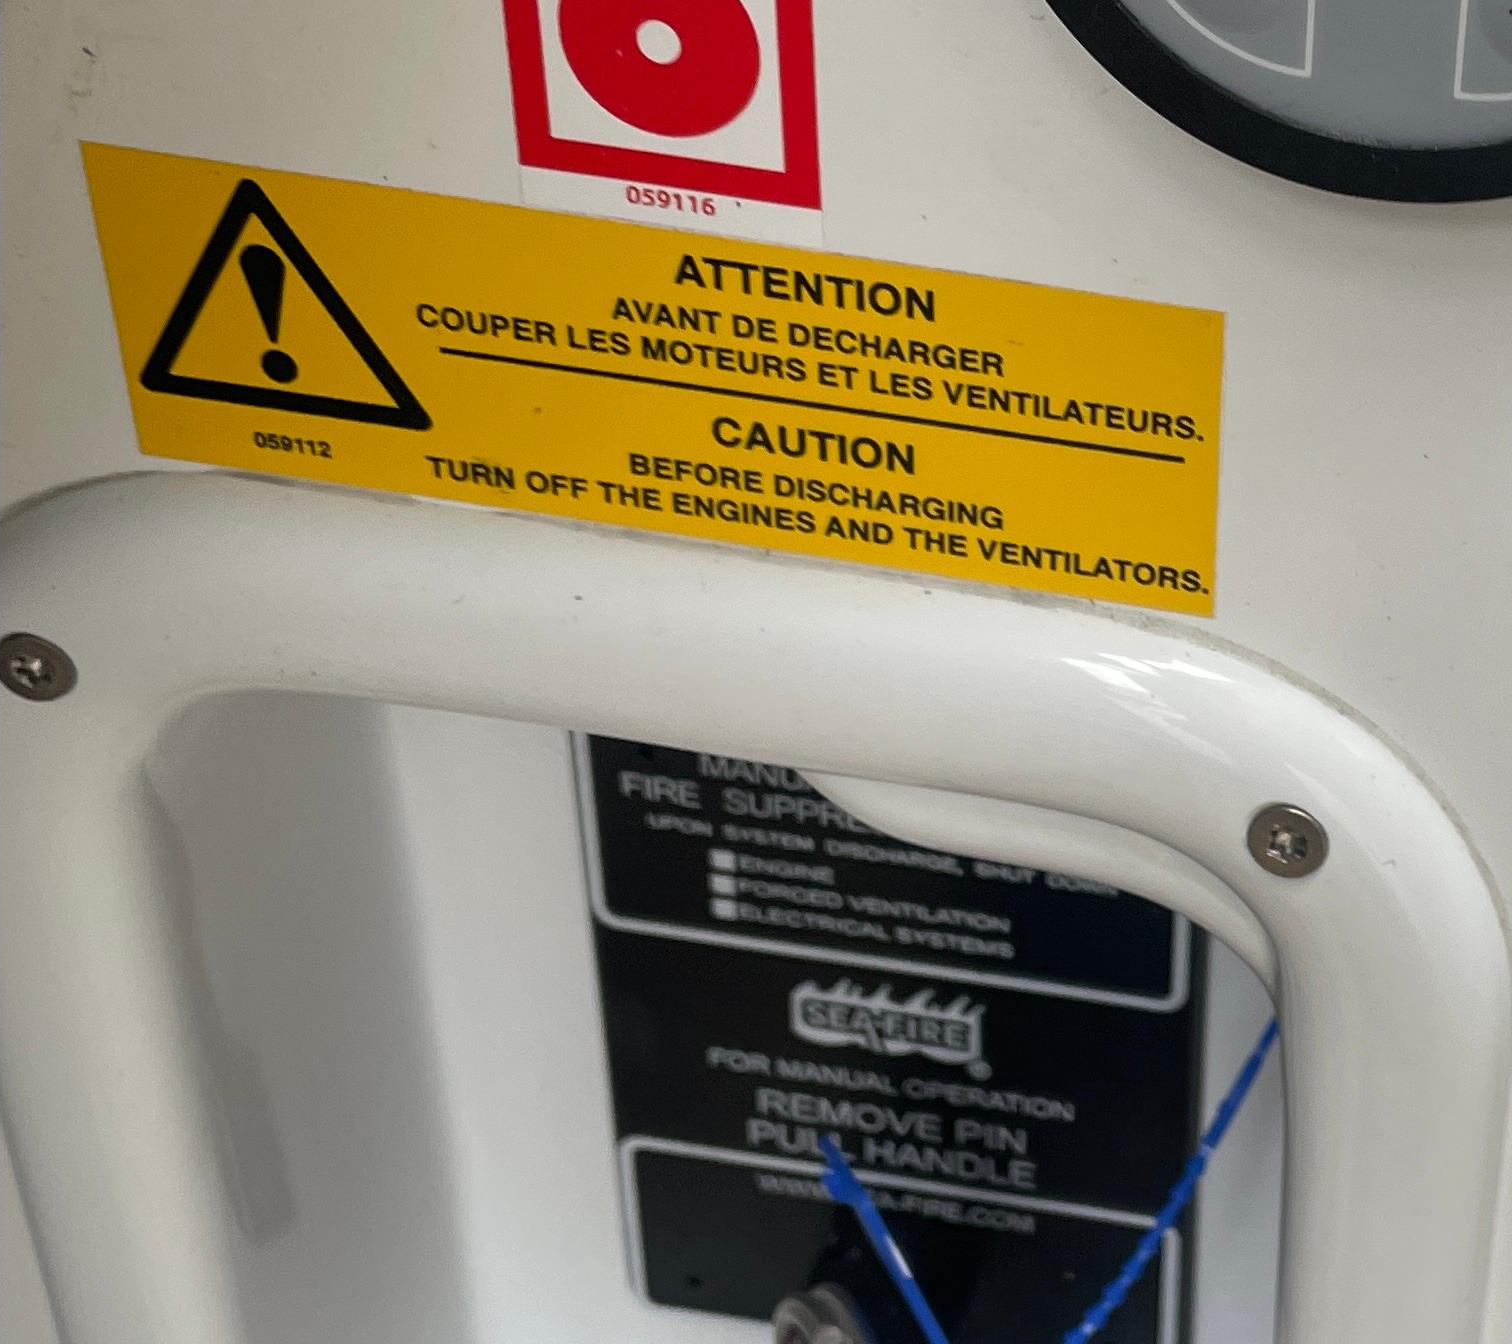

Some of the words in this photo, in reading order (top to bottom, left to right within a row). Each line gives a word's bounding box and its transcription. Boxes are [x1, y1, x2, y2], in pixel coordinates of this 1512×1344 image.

[625, 184, 716, 218] 059116
[674, 254, 936, 322] ATTENTION
[611, 297, 722, 335] AVANT
[732, 313, 778, 343] DE
[788, 323, 1005, 377] DECHARGER
[416, 302, 557, 347] COUPER
[567, 324, 631, 356] LES
[640, 335, 808, 382] MOTEURS
[818, 361, 859, 390] ET
[870, 369, 933, 400] LES
[942, 380, 1205, 443] VENTILATEURS.
[253, 432, 332, 459] 059112
[711, 416, 916, 475] CAUTION
[628, 452, 764, 495] BEFORE
[774, 474, 1005, 531] DISCHARGING
[424, 455, 516, 490] TURN
[525, 471, 588, 499] OFF
[596, 480, 663, 512] THE
[672, 492, 816, 535] ENGINES
[825, 515, 894, 546] AND
[902, 526, 968, 557] THE
[977, 537, 1210, 595] VENTILATORS.
[617, 769, 702, 810] FIRE
[644, 810, 714, 838] UPON
[721, 822, 817, 852] SYSTEM
[973, 860, 1035, 885] SHUT
[738, 854, 836, 887] ENGINE
[737, 876, 845, 910] FORCED
[846, 893, 1012, 935] VENTILATION
[738, 902, 891, 942] ELECTRICAL
[892, 925, 1016, 960] SYSTEMS
[802, 1001, 972, 1050] SEA-FIRE
[705, 1045, 772, 1077] FOR
[775, 1058, 899, 1097] MANUAL
[901, 1077, 1077, 1124] OPERATION
[753, 1087, 944, 1143] REMOVE
[954, 1118, 1029, 1156] PIN
[861, 1136, 1038, 1190] HANDLE
